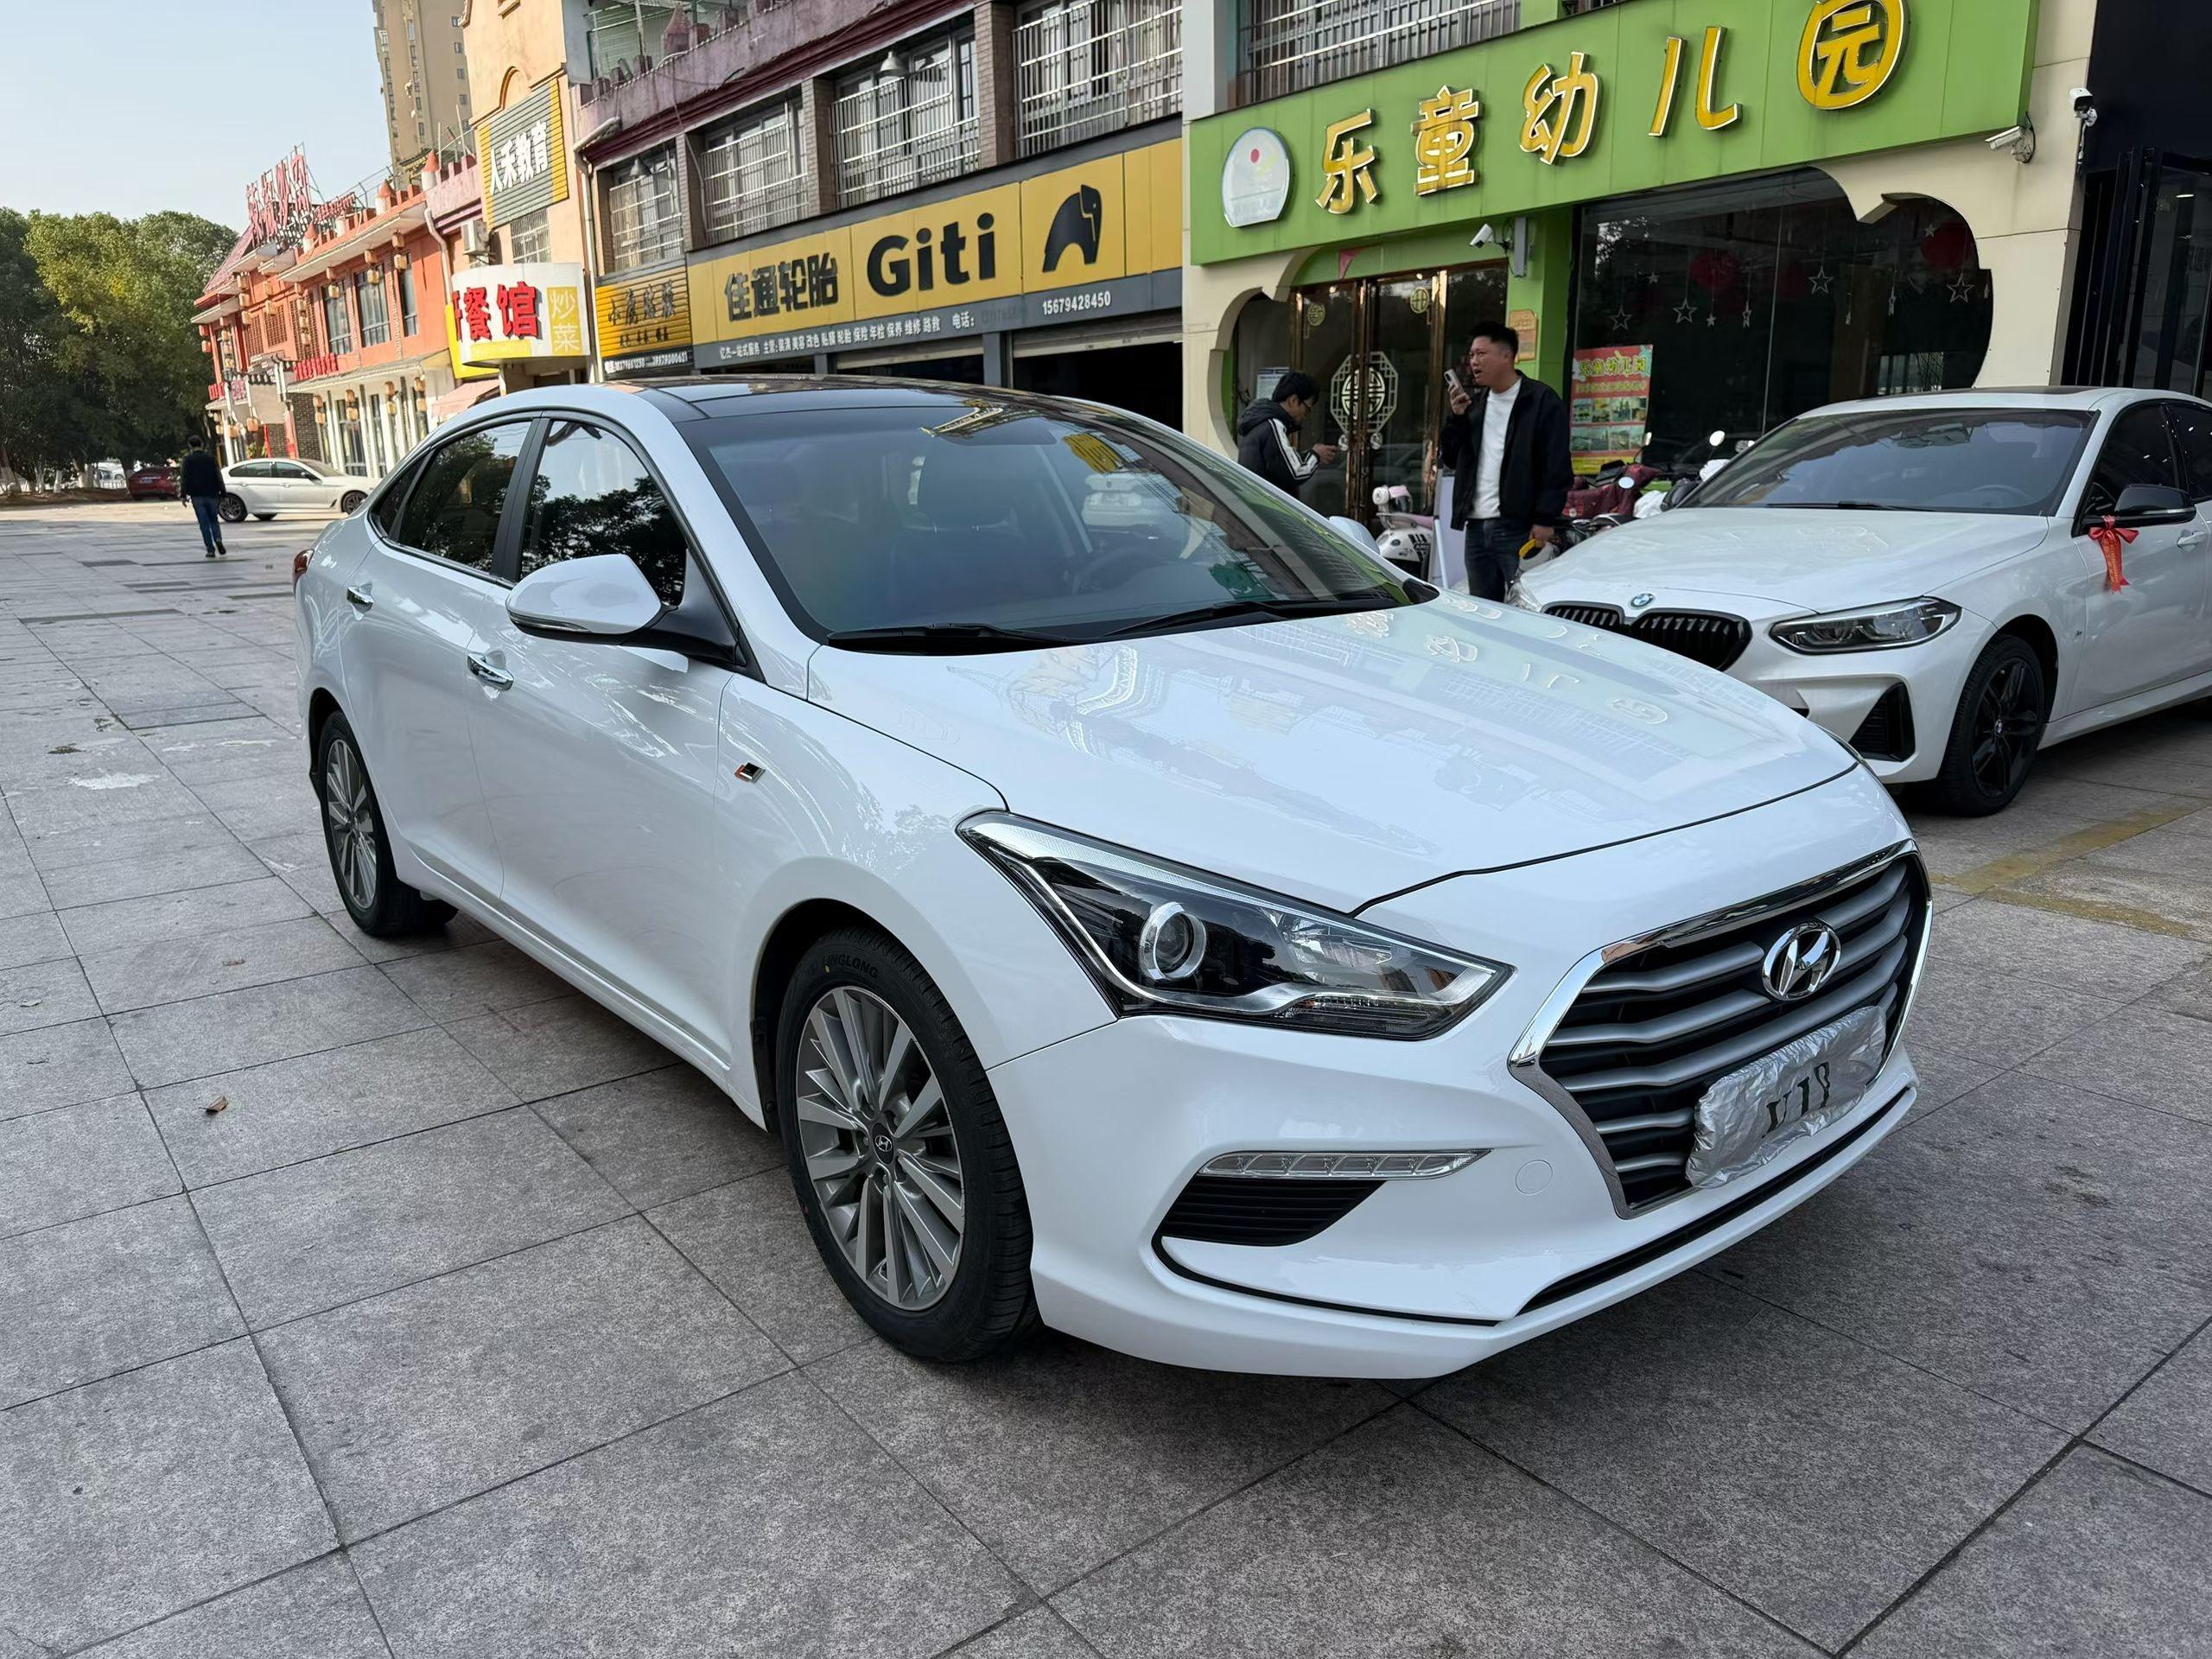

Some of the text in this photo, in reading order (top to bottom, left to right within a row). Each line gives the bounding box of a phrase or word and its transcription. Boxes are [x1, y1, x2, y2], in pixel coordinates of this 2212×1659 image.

[1314, 0, 1908, 215] 乐童幼儿园
[723, 251, 839, 322] 佳通轮胎
[866, 212, 996, 297] Giti
[550, 289, 581, 352] 炒菜
[1042, 290, 1111, 315] 15679428450
